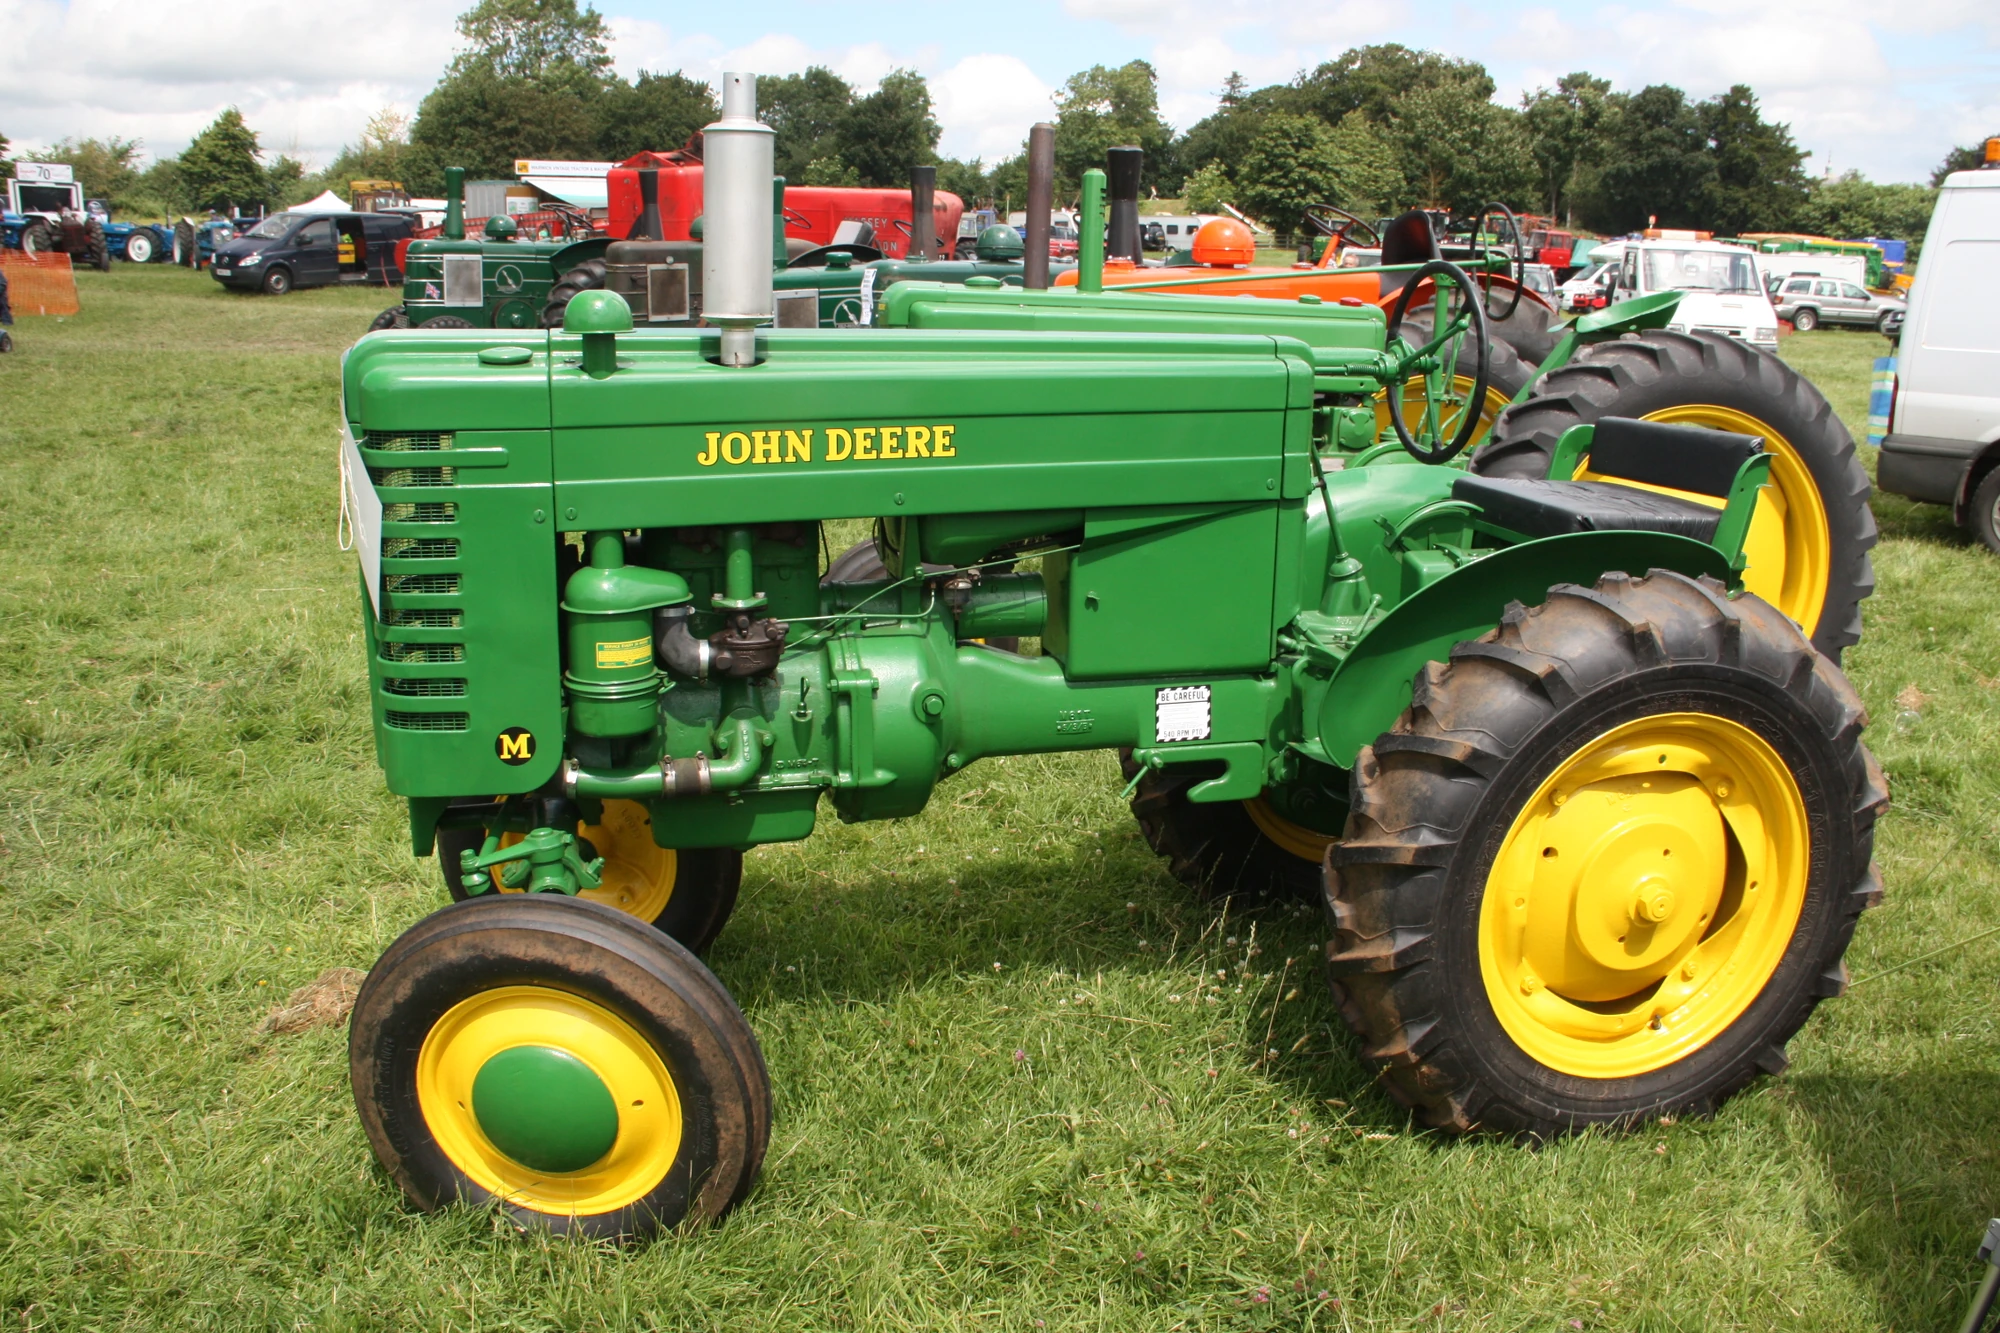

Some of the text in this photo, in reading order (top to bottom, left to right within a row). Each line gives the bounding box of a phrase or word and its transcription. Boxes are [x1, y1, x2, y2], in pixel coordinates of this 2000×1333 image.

[36, 165, 51, 180] 70
[697, 424, 957, 466] JOHN DEERE
[1161, 691, 1205, 702] BE CAREFUL
[1163, 728, 1203, 738] 540 RPM PTO
[499, 733, 532, 759] M
